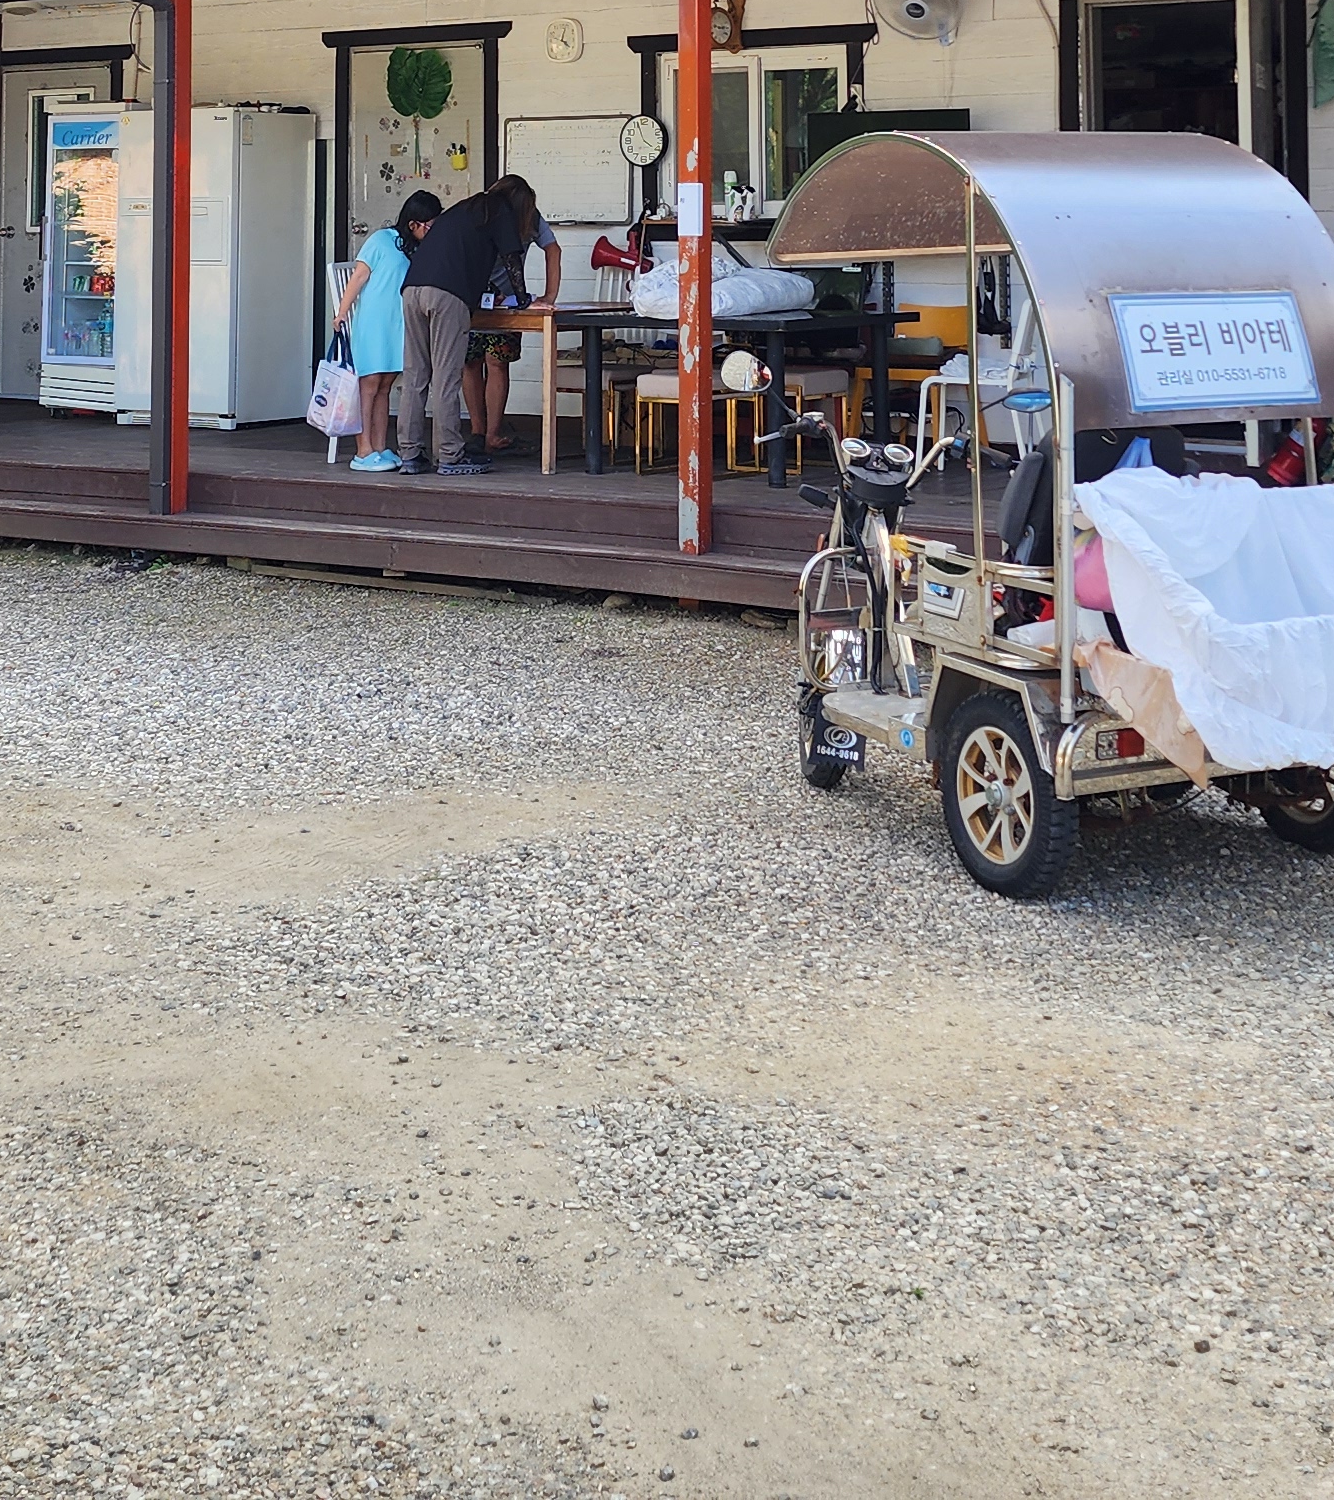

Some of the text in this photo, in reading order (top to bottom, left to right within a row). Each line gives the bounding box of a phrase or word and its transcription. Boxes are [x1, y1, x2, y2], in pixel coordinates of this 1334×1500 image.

[62, 130, 112, 146] Carrier
[1139, 318, 1293, 357] 오블리 비아테
[1157, 366, 1287, 386] 관리실 010-5531-6718
